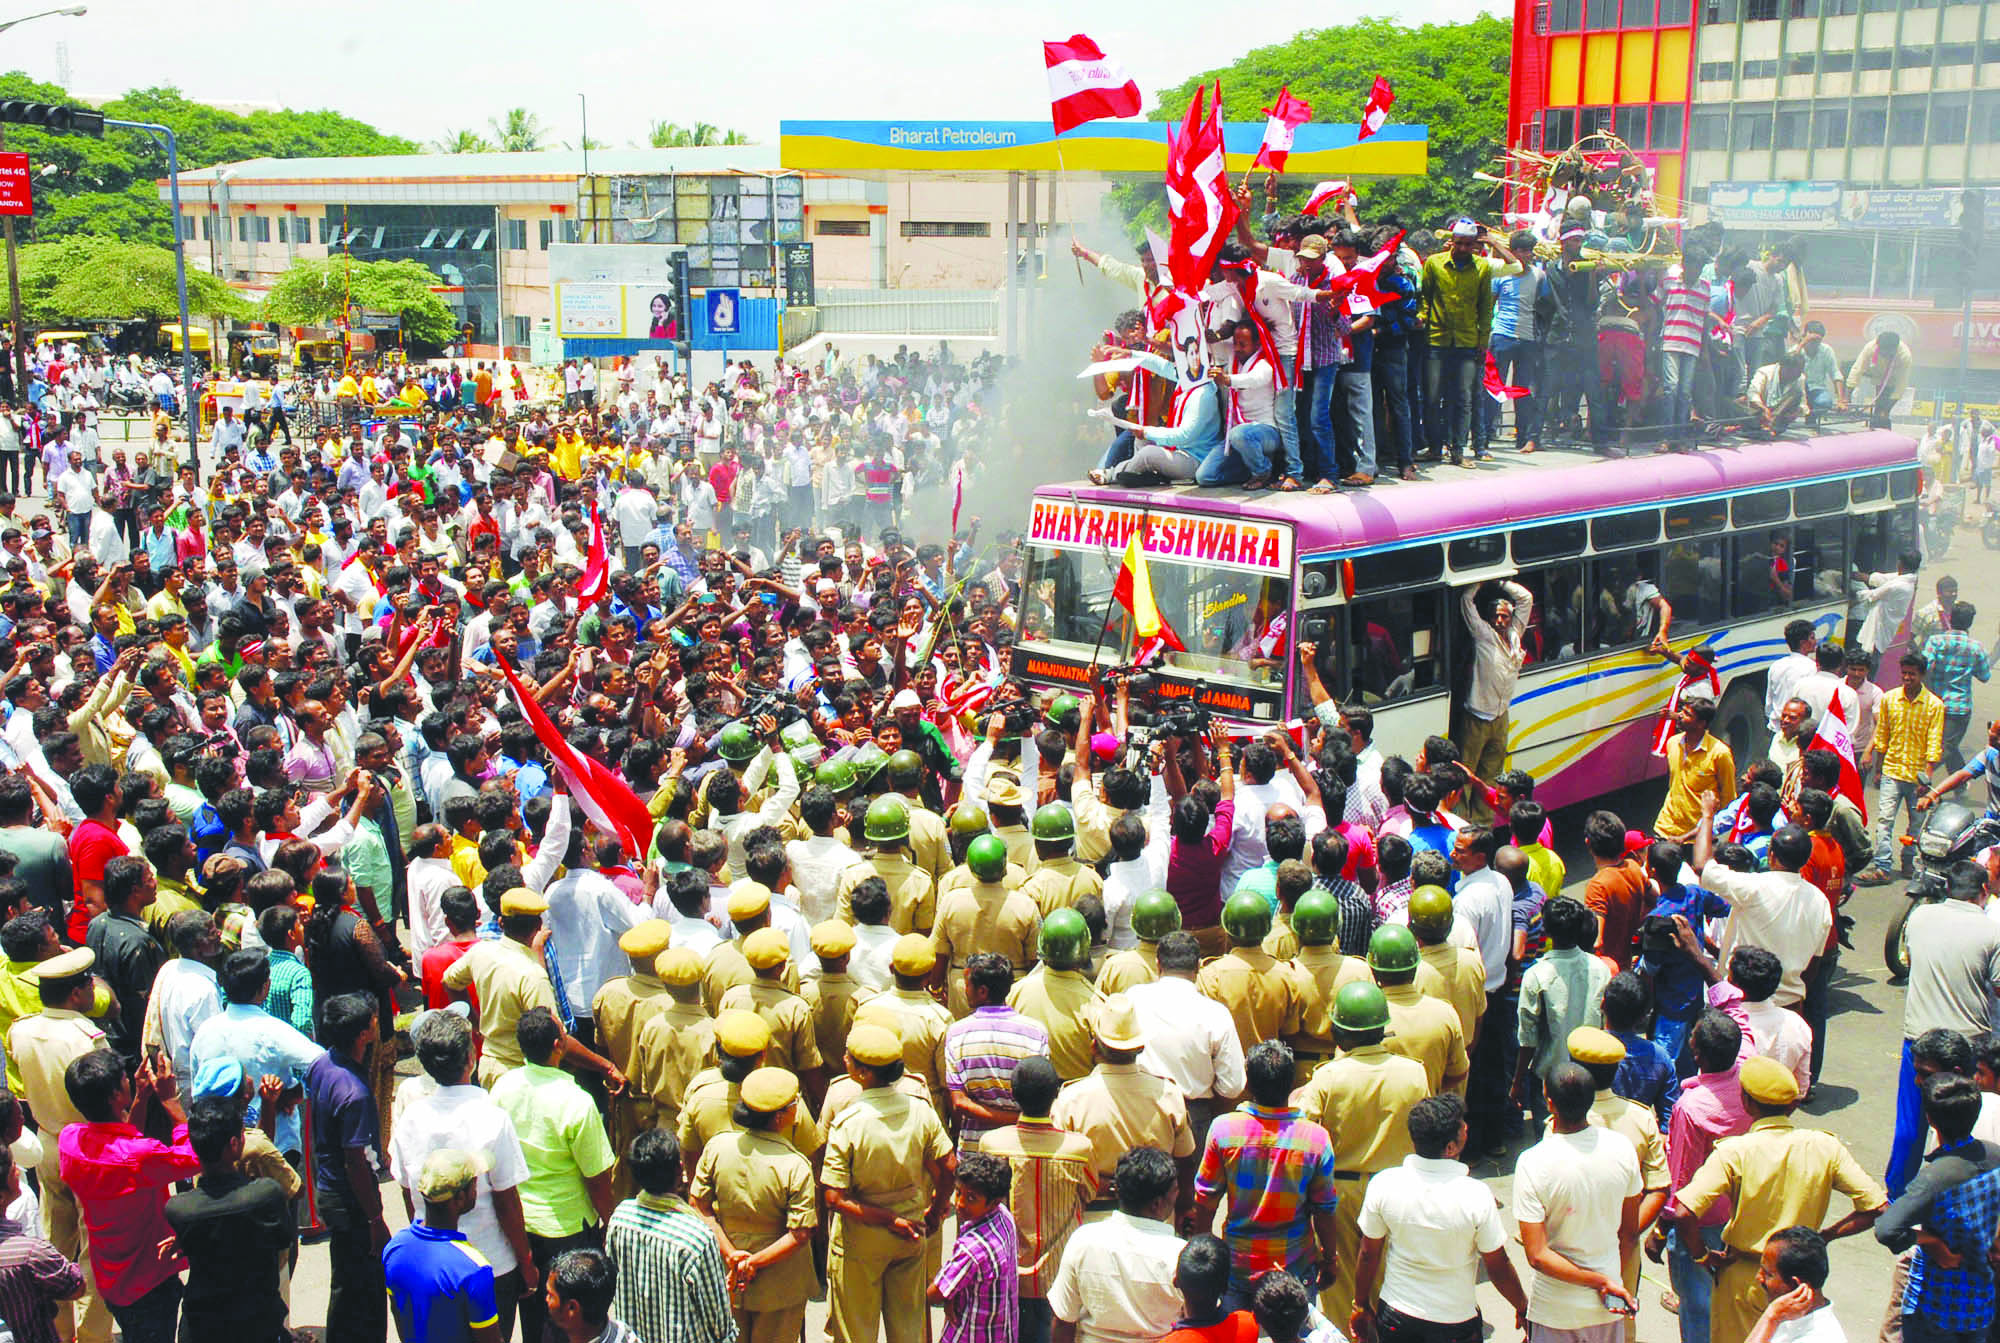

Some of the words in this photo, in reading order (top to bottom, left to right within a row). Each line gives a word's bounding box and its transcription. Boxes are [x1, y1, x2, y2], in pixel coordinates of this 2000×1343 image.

[889, 127, 940, 144] Bharat
[942, 127, 1017, 144] Petroleum
[14, 168, 25, 176] 4G
[1784, 208, 1821, 220] SALOON
[1031, 503, 1280, 568] BHAYRAWESHWARA
[1212, 691, 1251, 711] AMMA
